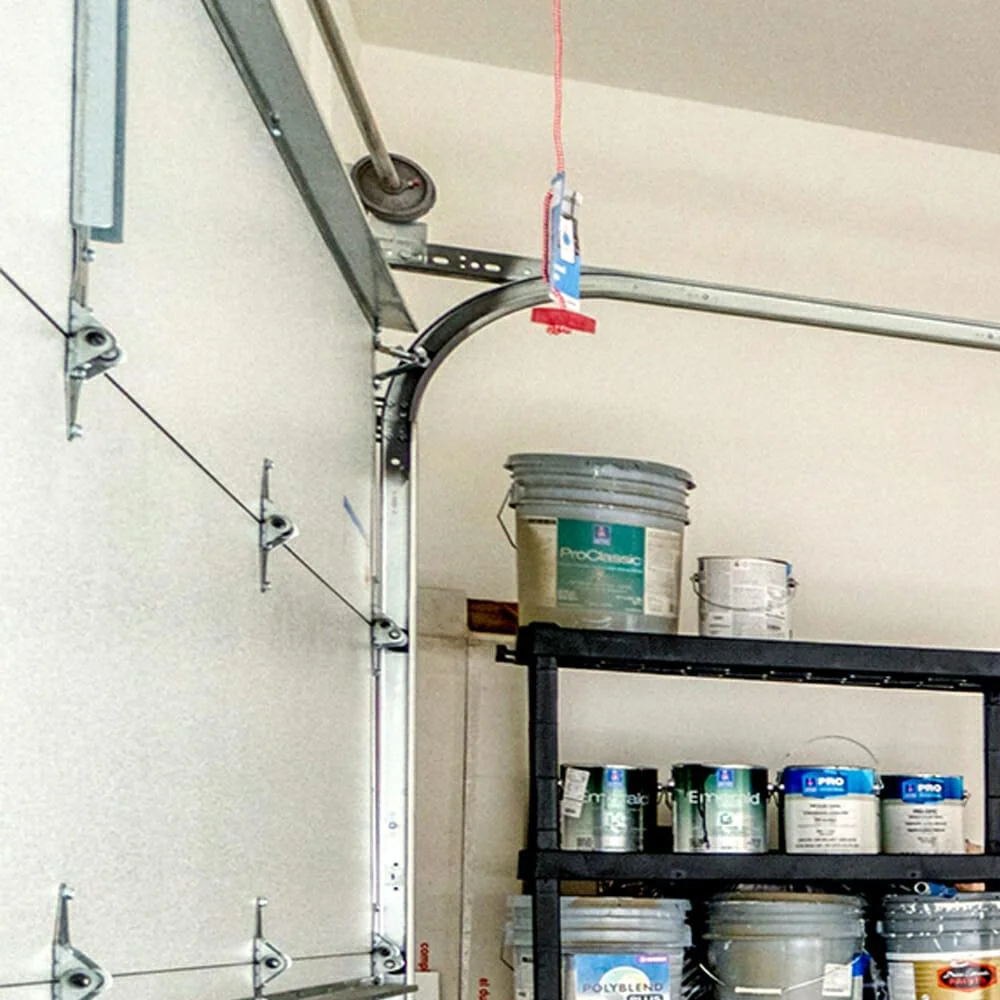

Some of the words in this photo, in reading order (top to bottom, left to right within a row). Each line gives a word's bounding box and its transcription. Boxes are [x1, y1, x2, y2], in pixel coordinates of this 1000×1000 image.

[560, 547, 642, 567] ProClassic
[817, 776, 845, 786] PRO
[917, 783, 943, 793] PRO
[582, 983, 664, 993] POLYBLEND
